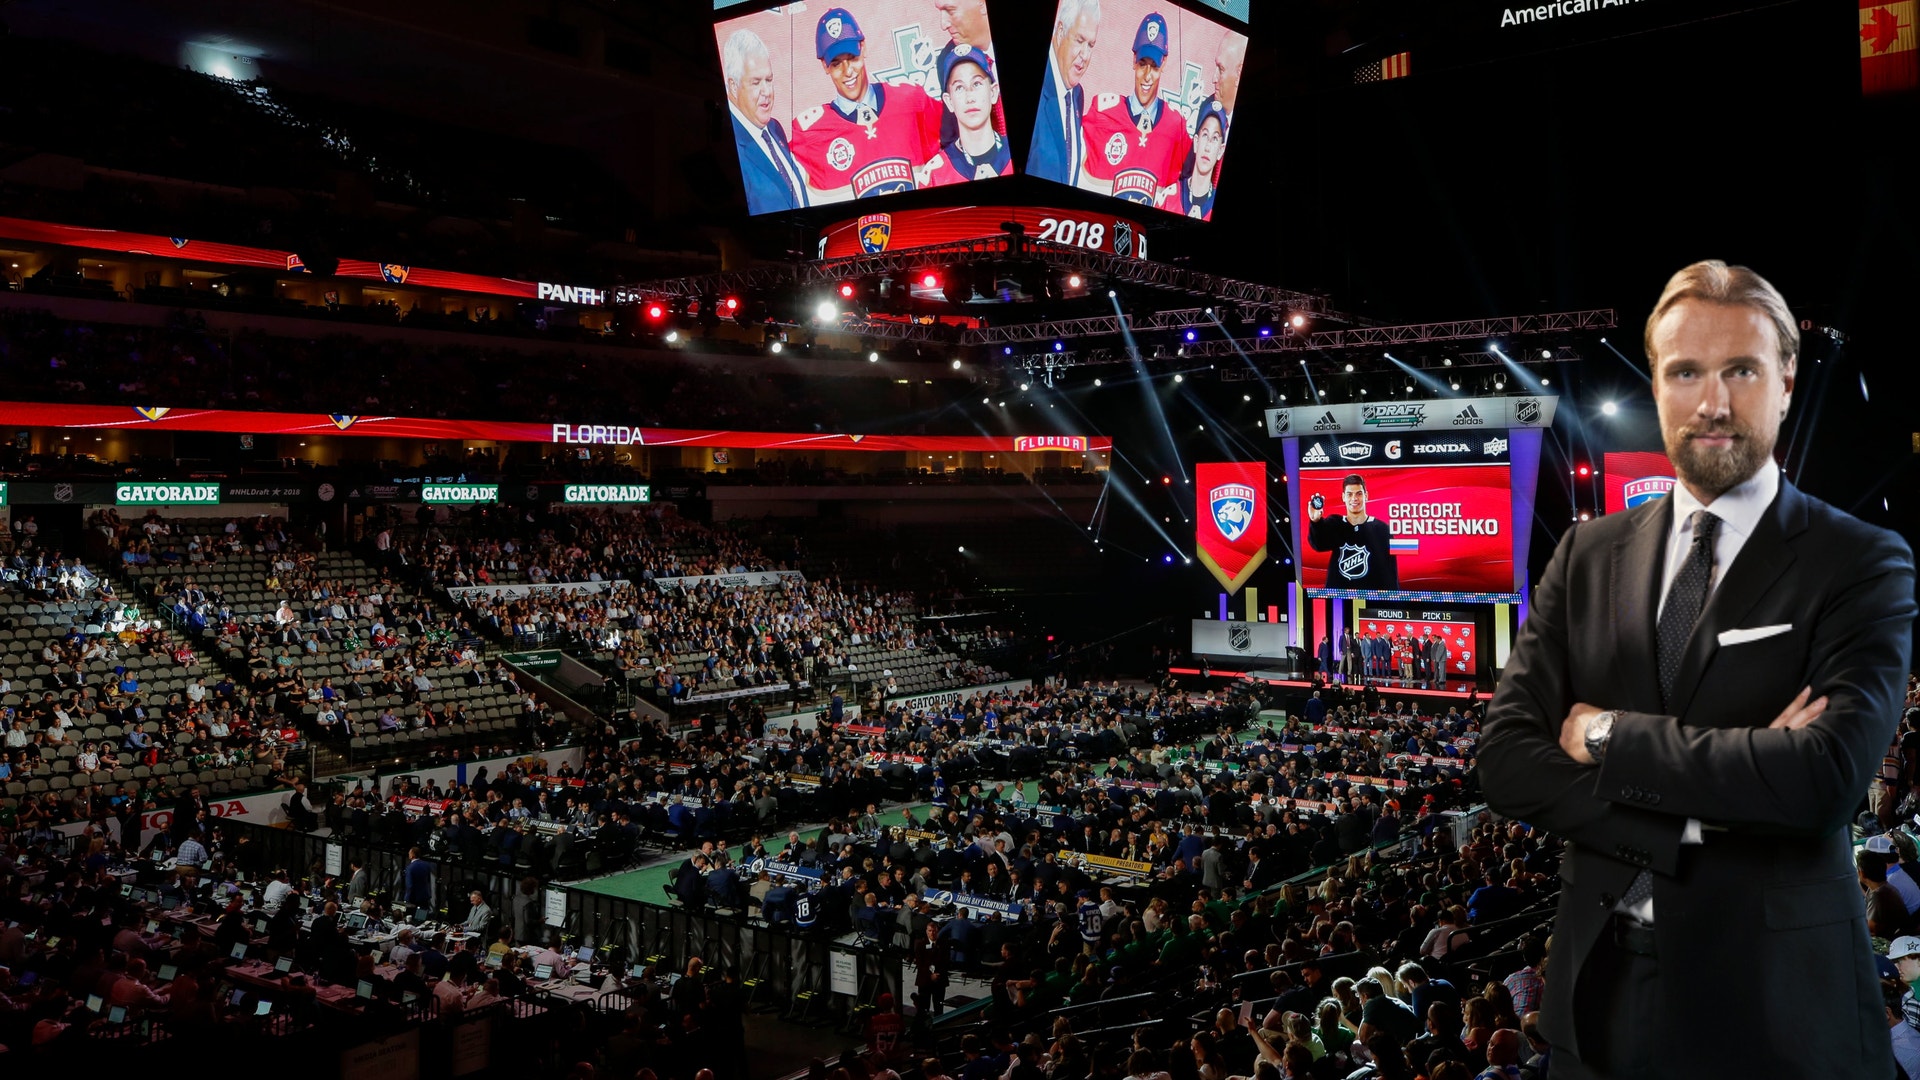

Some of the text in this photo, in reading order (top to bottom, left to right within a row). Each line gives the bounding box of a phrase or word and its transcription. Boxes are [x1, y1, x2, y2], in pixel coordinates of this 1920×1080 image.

[1501, 0, 1600, 28] American
[857, 164, 908, 191] PANTHERS
[1117, 174, 1154, 193] PANTHERS
[861, 214, 889, 226] FLORIDA
[1037, 218, 1105, 249] 2018
[1375, 405, 1423, 416] DRAFT
[1313, 423, 1341, 432] adidas
[1453, 415, 1484, 425] adidas
[553, 423, 645, 446] FLORIDA
[1021, 436, 1080, 451] FLORIDA
[1342, 444, 1370, 456] Denny's
[1413, 443, 1471, 453] HONDA
[1302, 455, 1330, 463] adidas
[116, 486, 219, 502] GATORADE
[229, 487, 301, 496] #NHLDraft 2018
[421, 487, 498, 501] GATORADE
[565, 486, 649, 502] GATORADE
[1213, 487, 1250, 499] FLORIDA
[1630, 481, 1672, 495] FLORID
[1389, 503, 1462, 518] GRIGORI
[1389, 518, 1499, 535] DENISENKO
[1343, 551, 1364, 570] NHL
[1377, 610, 1451, 620] ROUND 1 PICK 15
[911, 692, 958, 710] GATORADE
[768, 860, 798, 873] WINNIPEG JETS
[956, 893, 1009, 911] TAMPA BAY LIGHTNING
[797, 902, 810, 918] 18
[1086, 915, 1101, 934] 18
[876, 1031, 899, 1051] 67
